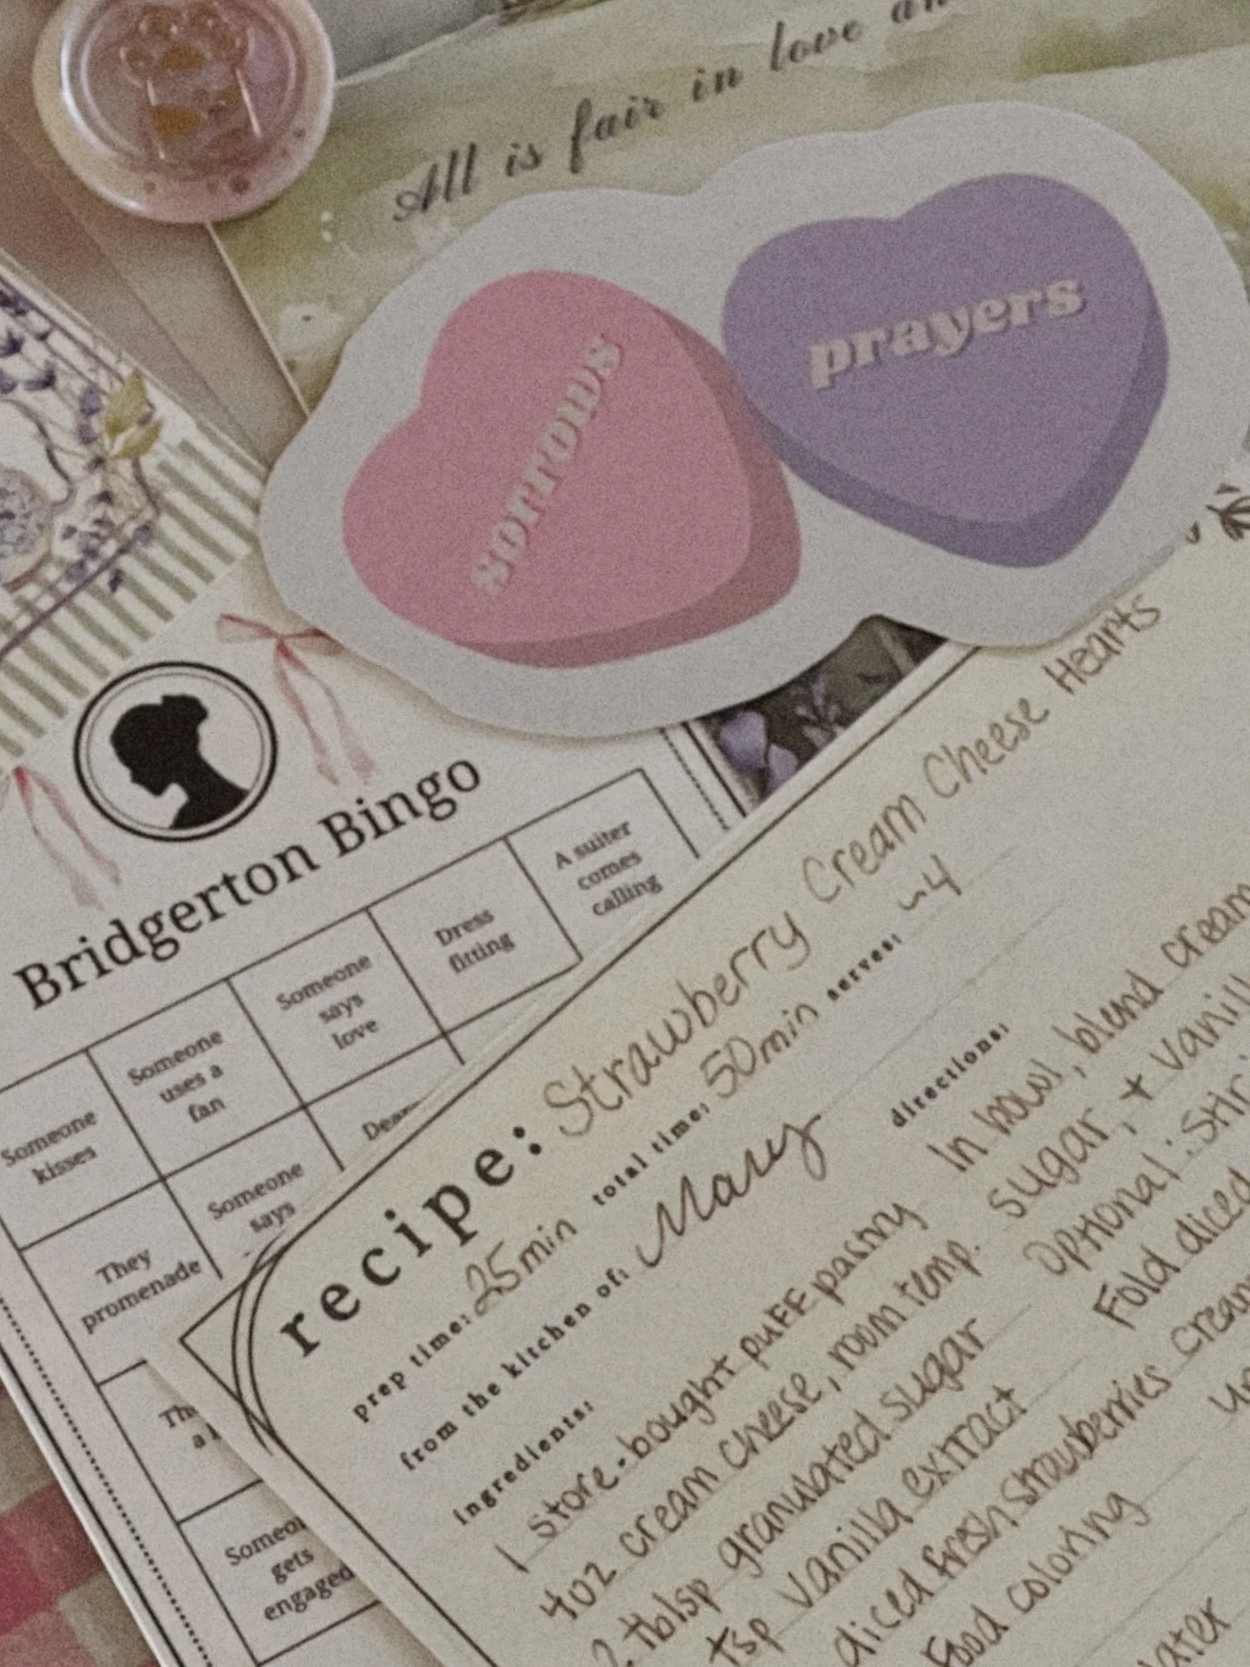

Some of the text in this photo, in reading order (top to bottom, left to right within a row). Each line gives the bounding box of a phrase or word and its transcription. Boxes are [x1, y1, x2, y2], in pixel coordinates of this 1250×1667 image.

[392, 142, 478, 223] All
[505, 142, 543, 178] is
[569, 97, 662, 175] fair
[691, 63, 744, 103] in
[769, 20, 863, 73] love
[809, 278, 1086, 389] prayers
[470, 333, 624, 597] sorrows
[13, 757, 483, 1010] Bridgerton Bingo
[543, 593, 1161, 1137] Strawberry Cream Cheese Hearts
[554, 819, 633, 871] A suiter
[577, 850, 643, 892] comes
[434, 908, 496, 948] Dress
[592, 874, 663, 918] calling
[276, 953, 372, 1012] Someone
[449, 931, 516, 975] fitting
[827, 934, 902, 1001] serves:
[318, 991, 364, 1027] says
[331, 1016, 380, 1051] love
[127, 1030, 224, 1087] Someone
[159, 1063, 224, 1104] uses a
[891, 1023, 1010, 1128] directions:
[927, 1134, 989, 1173] In
[1052, 969, 1165, 1054] blend
[0, 1109, 98, 1168] Someone
[188, 1095, 227, 1125] fan
[31, 1144, 98, 1186] kisses
[208, 1161, 305, 1221] Someone
[593, 1102, 710, 1206] total time:
[636, 1114, 827, 1268] Mary
[250, 1200, 296, 1233] says
[280, 1125, 543, 1358] recipe:
[812, 1203, 930, 1307] pastry
[81, 1256, 203, 1334] promenade
[95, 1248, 152, 1288] They
[1092, 1243, 1181, 1330] Fold
[353, 1313, 472, 1424] prep time:
[400, 1266, 633, 1471] from the kitchen of:
[454, 1400, 595, 1527] ingredients:
[619, 1464, 720, 1559] cream
[828, 1304, 908, 1371] room
[718, 1409, 892, 1579] granulated
[880, 1317, 985, 1423] sugar
[901, 1385, 1028, 1499] extract
[270, 1548, 314, 1585] gets
[834, 1567, 935, 1667] diced
[922, 1503, 1020, 1579] fresh
[1007, 1491, 1152, 1614] coloring
[1137, 1596, 1231, 1667] ater
